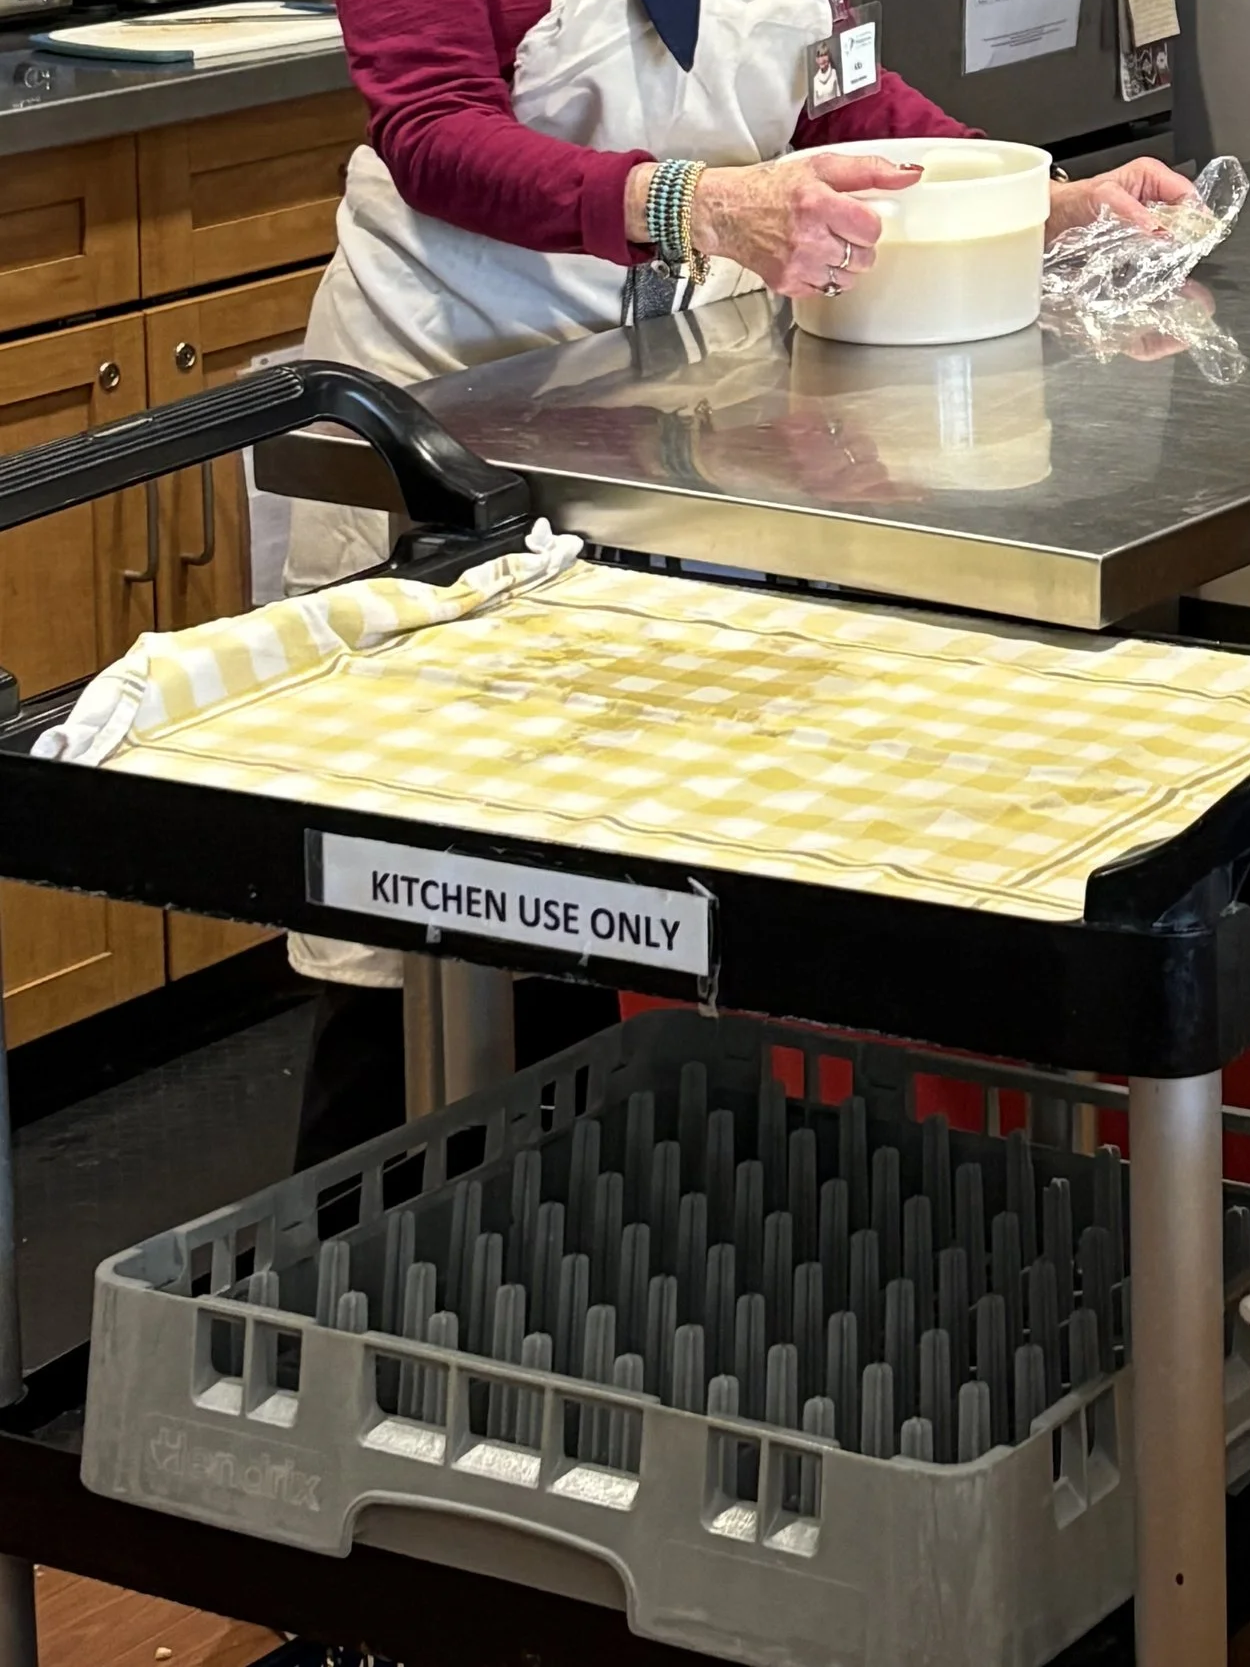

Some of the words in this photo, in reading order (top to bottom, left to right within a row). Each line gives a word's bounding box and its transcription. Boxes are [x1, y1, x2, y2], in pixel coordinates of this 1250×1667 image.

[372, 870, 507, 923] KITCHEN
[518, 894, 579, 935] USE
[590, 907, 680, 951] ONLY
